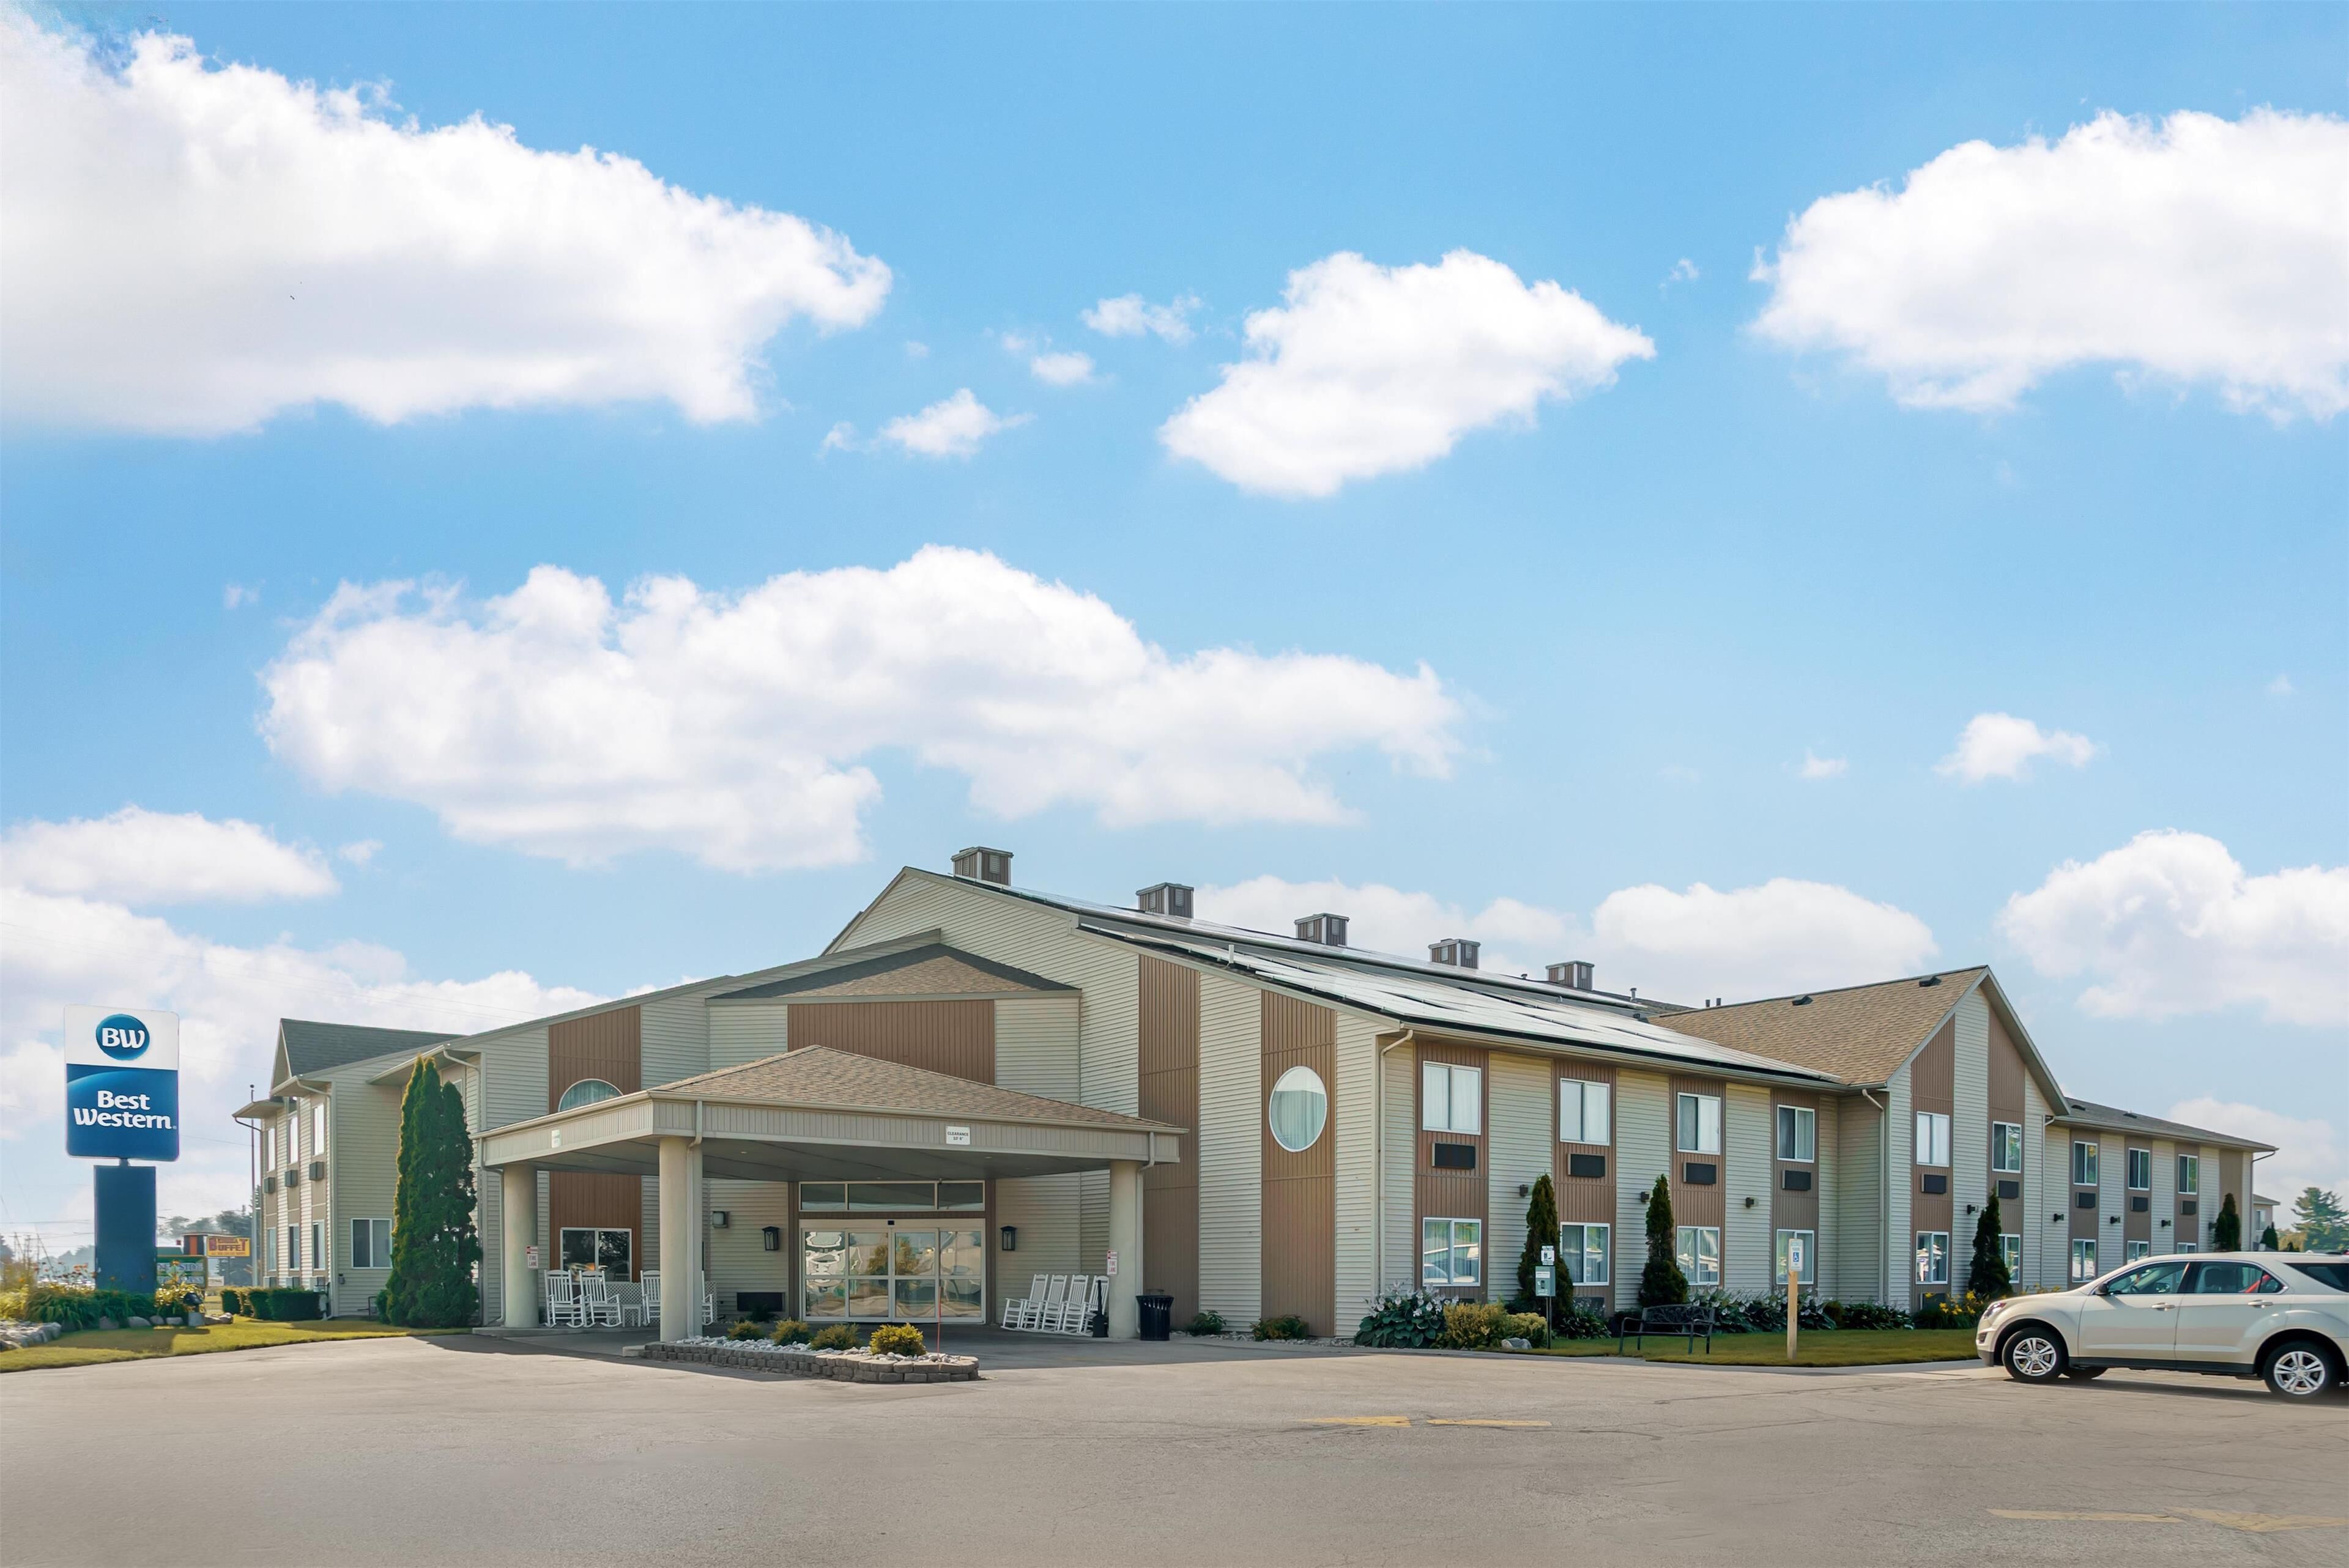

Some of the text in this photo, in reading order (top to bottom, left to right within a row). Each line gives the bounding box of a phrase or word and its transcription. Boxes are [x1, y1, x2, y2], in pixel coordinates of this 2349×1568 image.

[102, 1027, 146, 1049] BW
[97, 1090, 150, 1110] Best
[73, 1108, 172, 1130] Western
[209, 1238, 248, 1251] BUFFET
